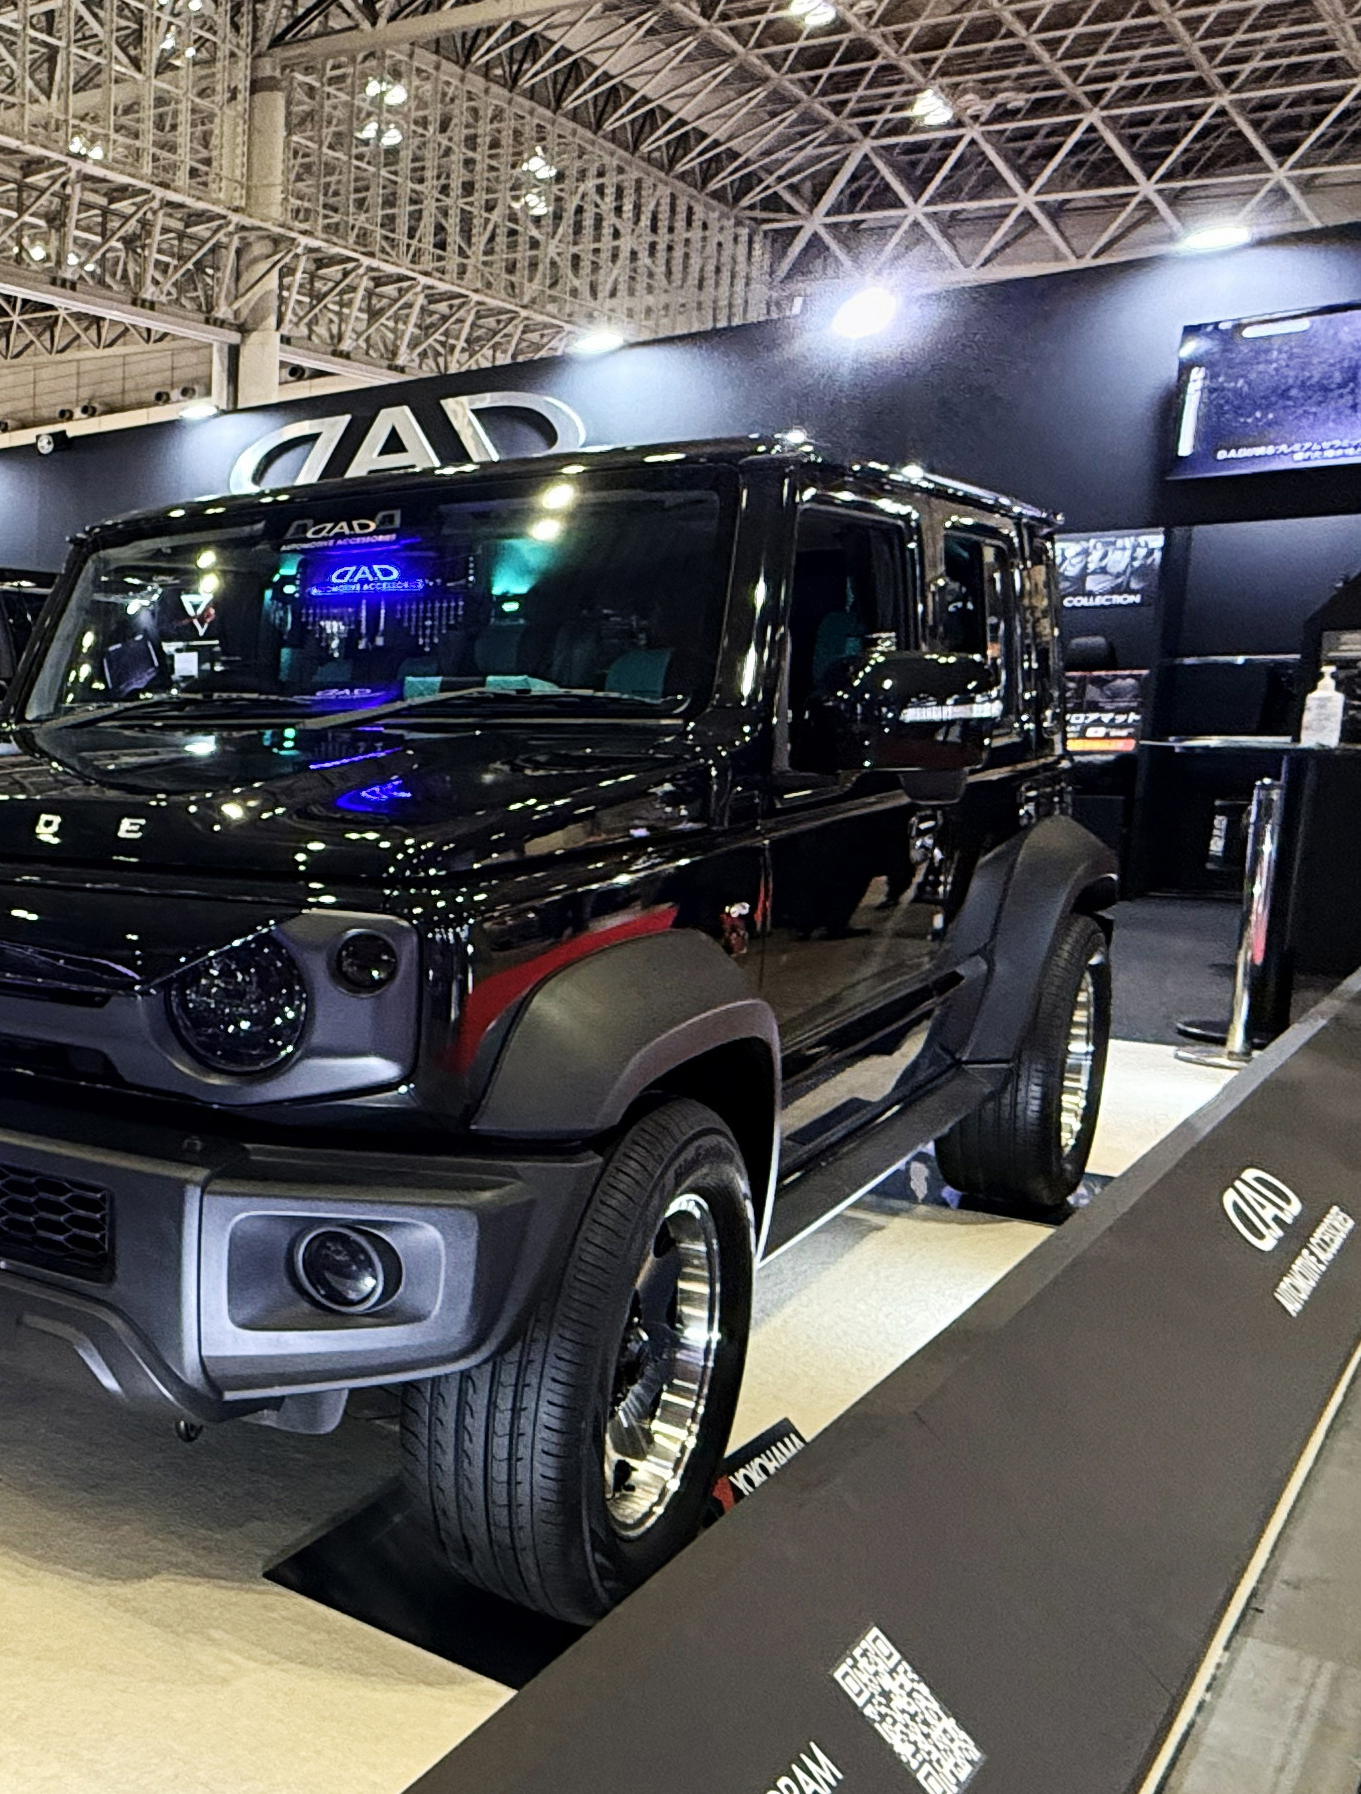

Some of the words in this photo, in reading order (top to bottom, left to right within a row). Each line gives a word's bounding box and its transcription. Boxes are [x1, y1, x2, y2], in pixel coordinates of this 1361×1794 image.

[1063, 593, 1142, 607] COLLECTION
[1273, 1248, 1327, 1317] AUTOMOTIVE
[1306, 1205, 1356, 1265] ACCESSORIES
[728, 1432, 805, 1496] YOKOHAMA
[765, 1741, 844, 1794] RAM
